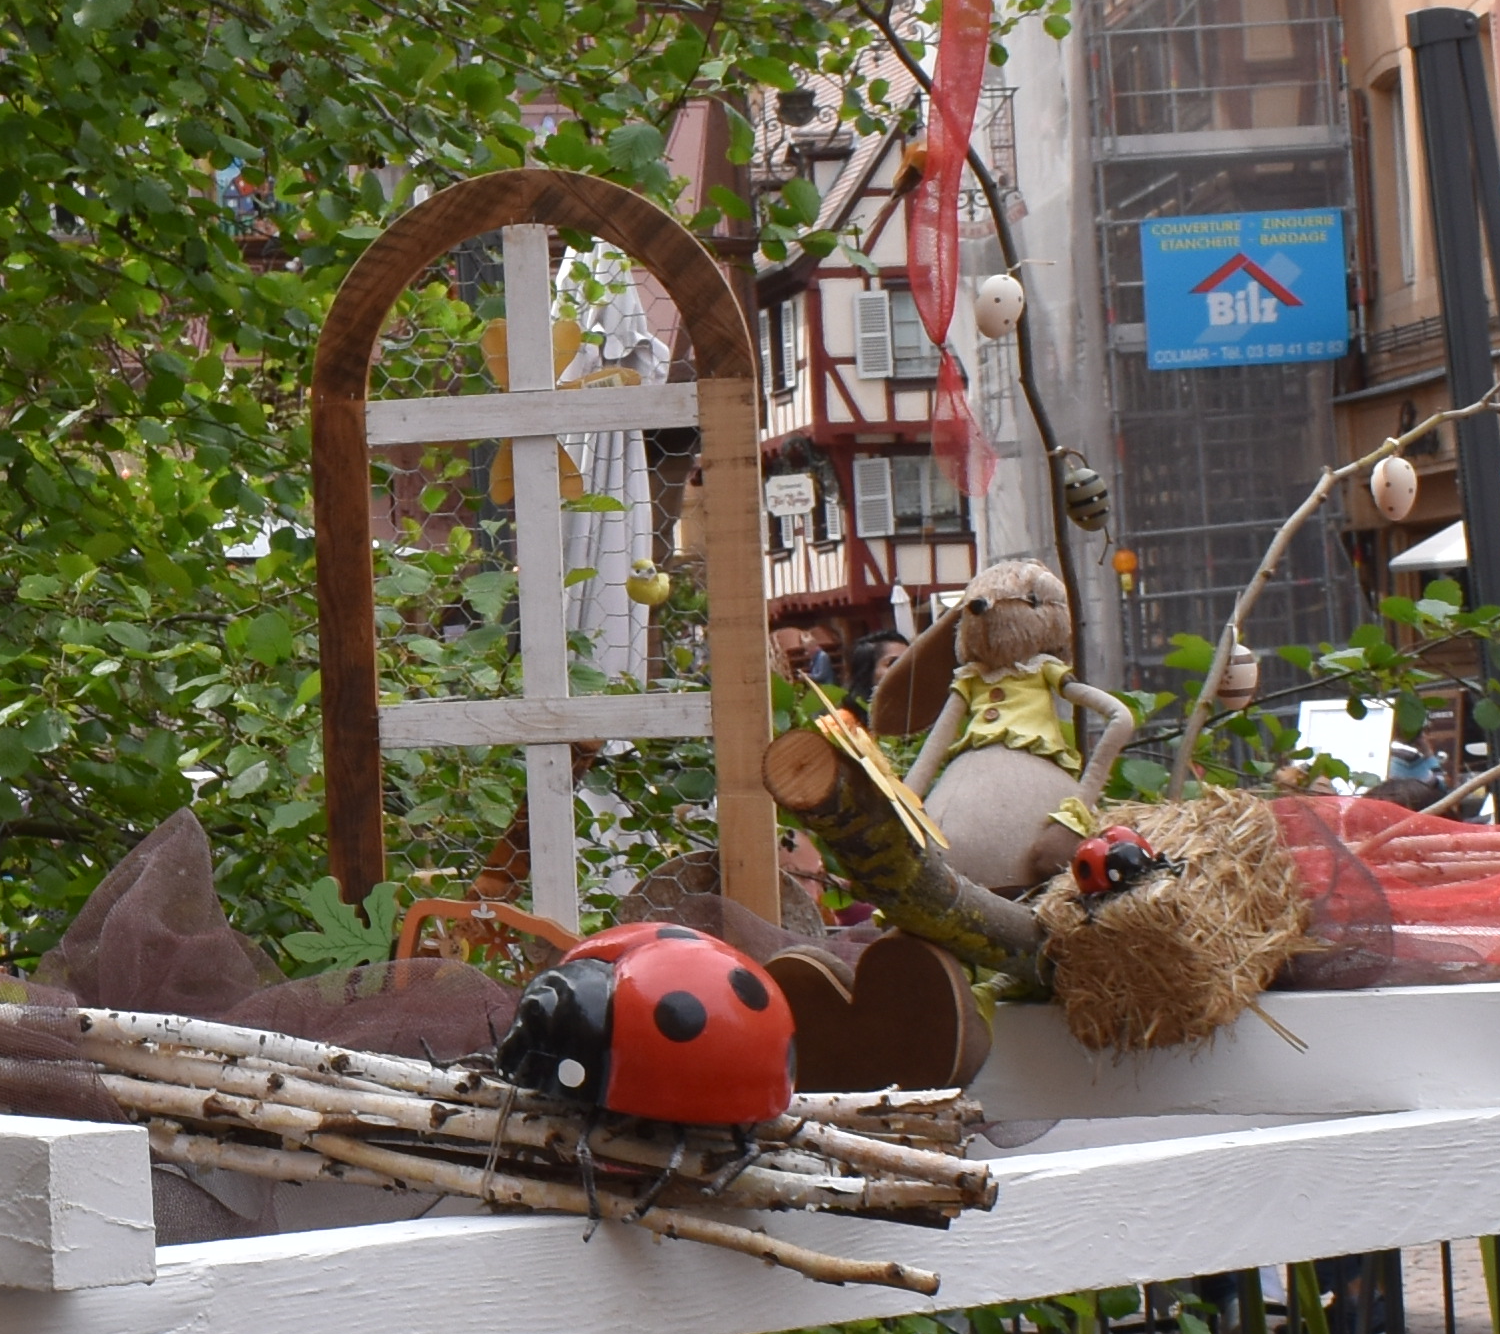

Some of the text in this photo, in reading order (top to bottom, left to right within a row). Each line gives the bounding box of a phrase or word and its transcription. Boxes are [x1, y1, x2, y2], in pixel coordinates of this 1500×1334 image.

[1152, 220, 1241, 236] COUVERTURE
[1262, 215, 1335, 230] ZINGUERIE
[1160, 236, 1240, 251] ETANCHEITE
[1260, 230, 1328, 246] BARDAGE
[1206, 280, 1278, 326] Bilz
[1154, 348, 1209, 364] COLMAR
[1286, 343, 1302, 356] 41
